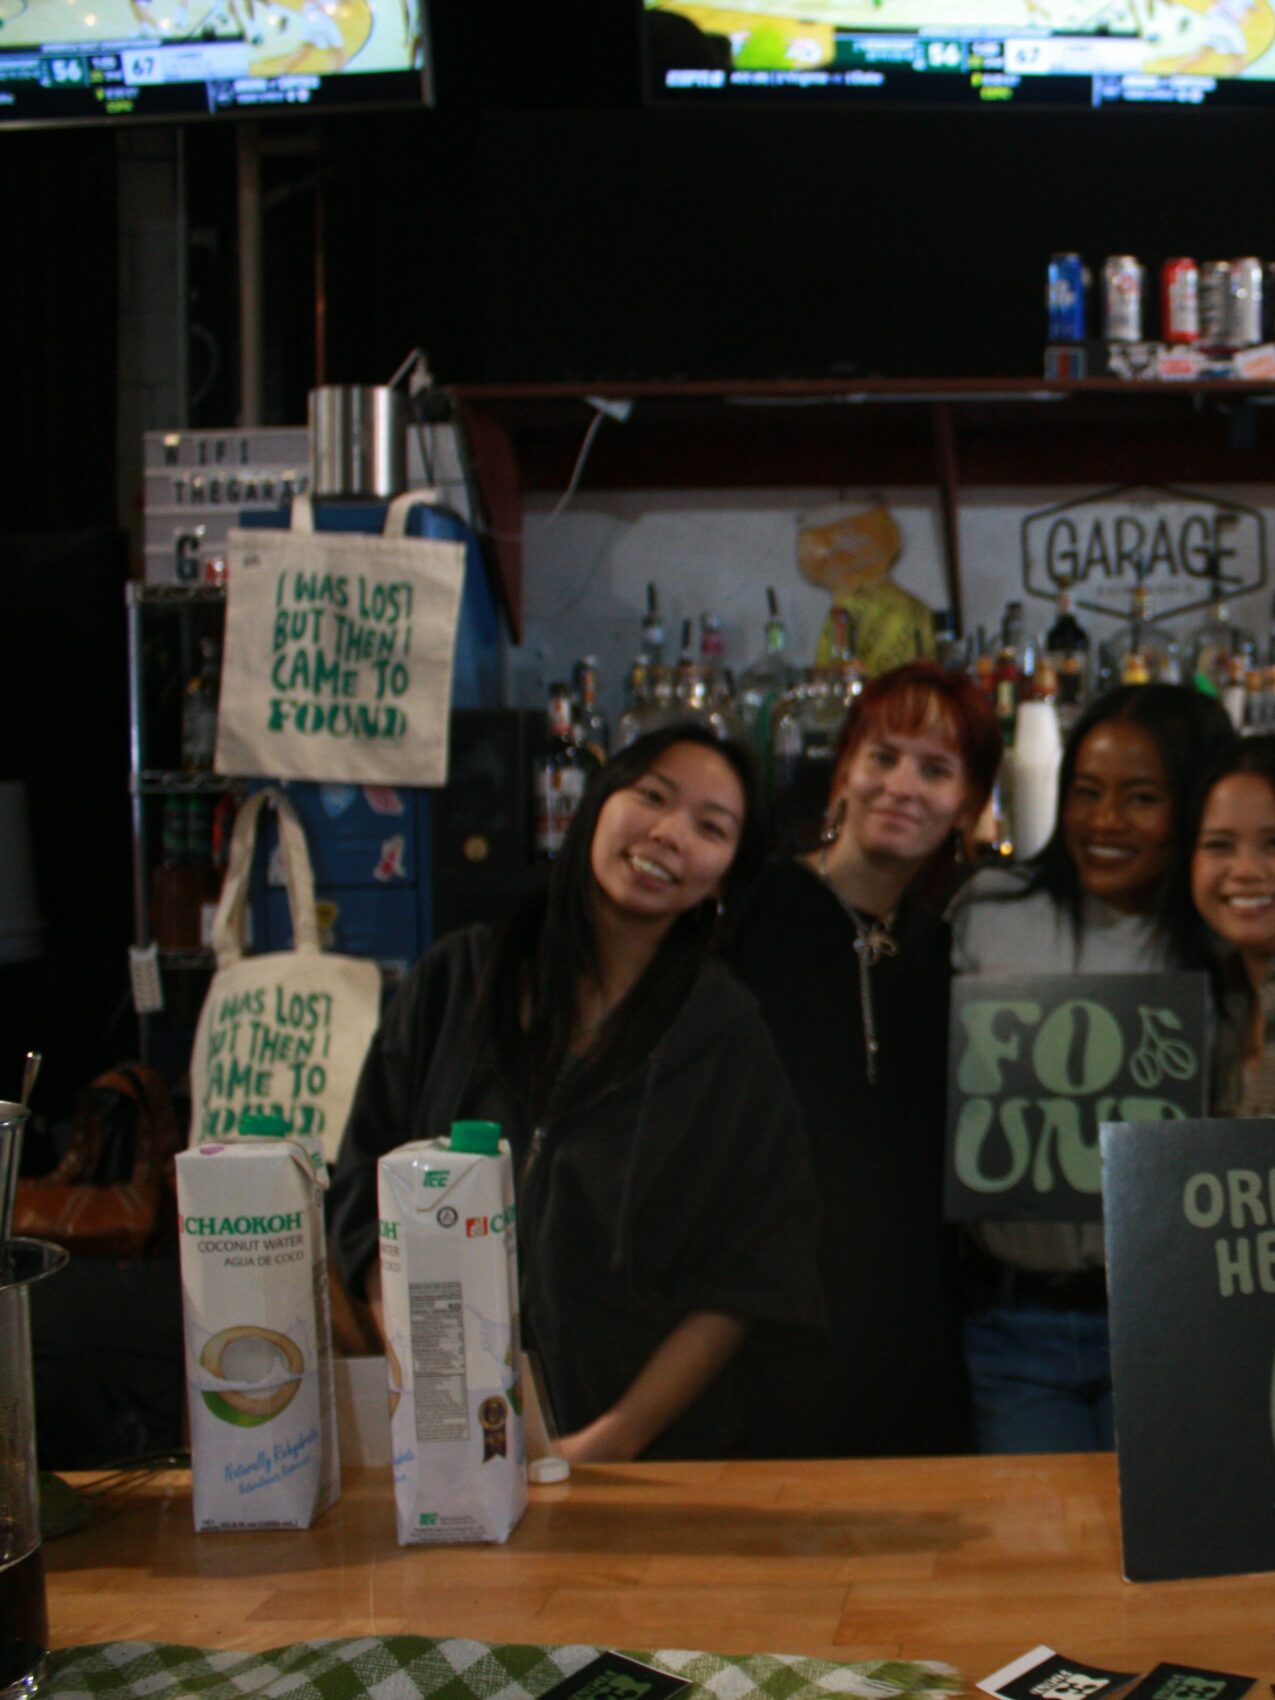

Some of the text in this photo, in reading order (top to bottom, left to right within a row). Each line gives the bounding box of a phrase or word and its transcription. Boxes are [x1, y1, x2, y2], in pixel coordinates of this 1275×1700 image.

[51, 59, 83, 82] 56
[131, 57, 156, 77] 67
[1046, 513, 1244, 585] GARAGE
[276, 570, 414, 623] I WAS LOST
[273, 608, 412, 662] BUT THEN I
[271, 648, 410, 699] CAME TO
[268, 699, 408, 740] FOUND
[219, 983, 332, 1031] WAS LOST
[209, 1022, 241, 1057] UT
[249, 1021, 315, 1066] THEN
[957, 999, 1124, 1096] FO
[211, 1057, 327, 1100] AME TO
[954, 1096, 1188, 1194] UN
[184, 1211, 304, 1236] CHAOKOH
[197, 1234, 304, 1253] COCONUT WATER
[224, 1251, 304, 1267] AGUA DE COCO
